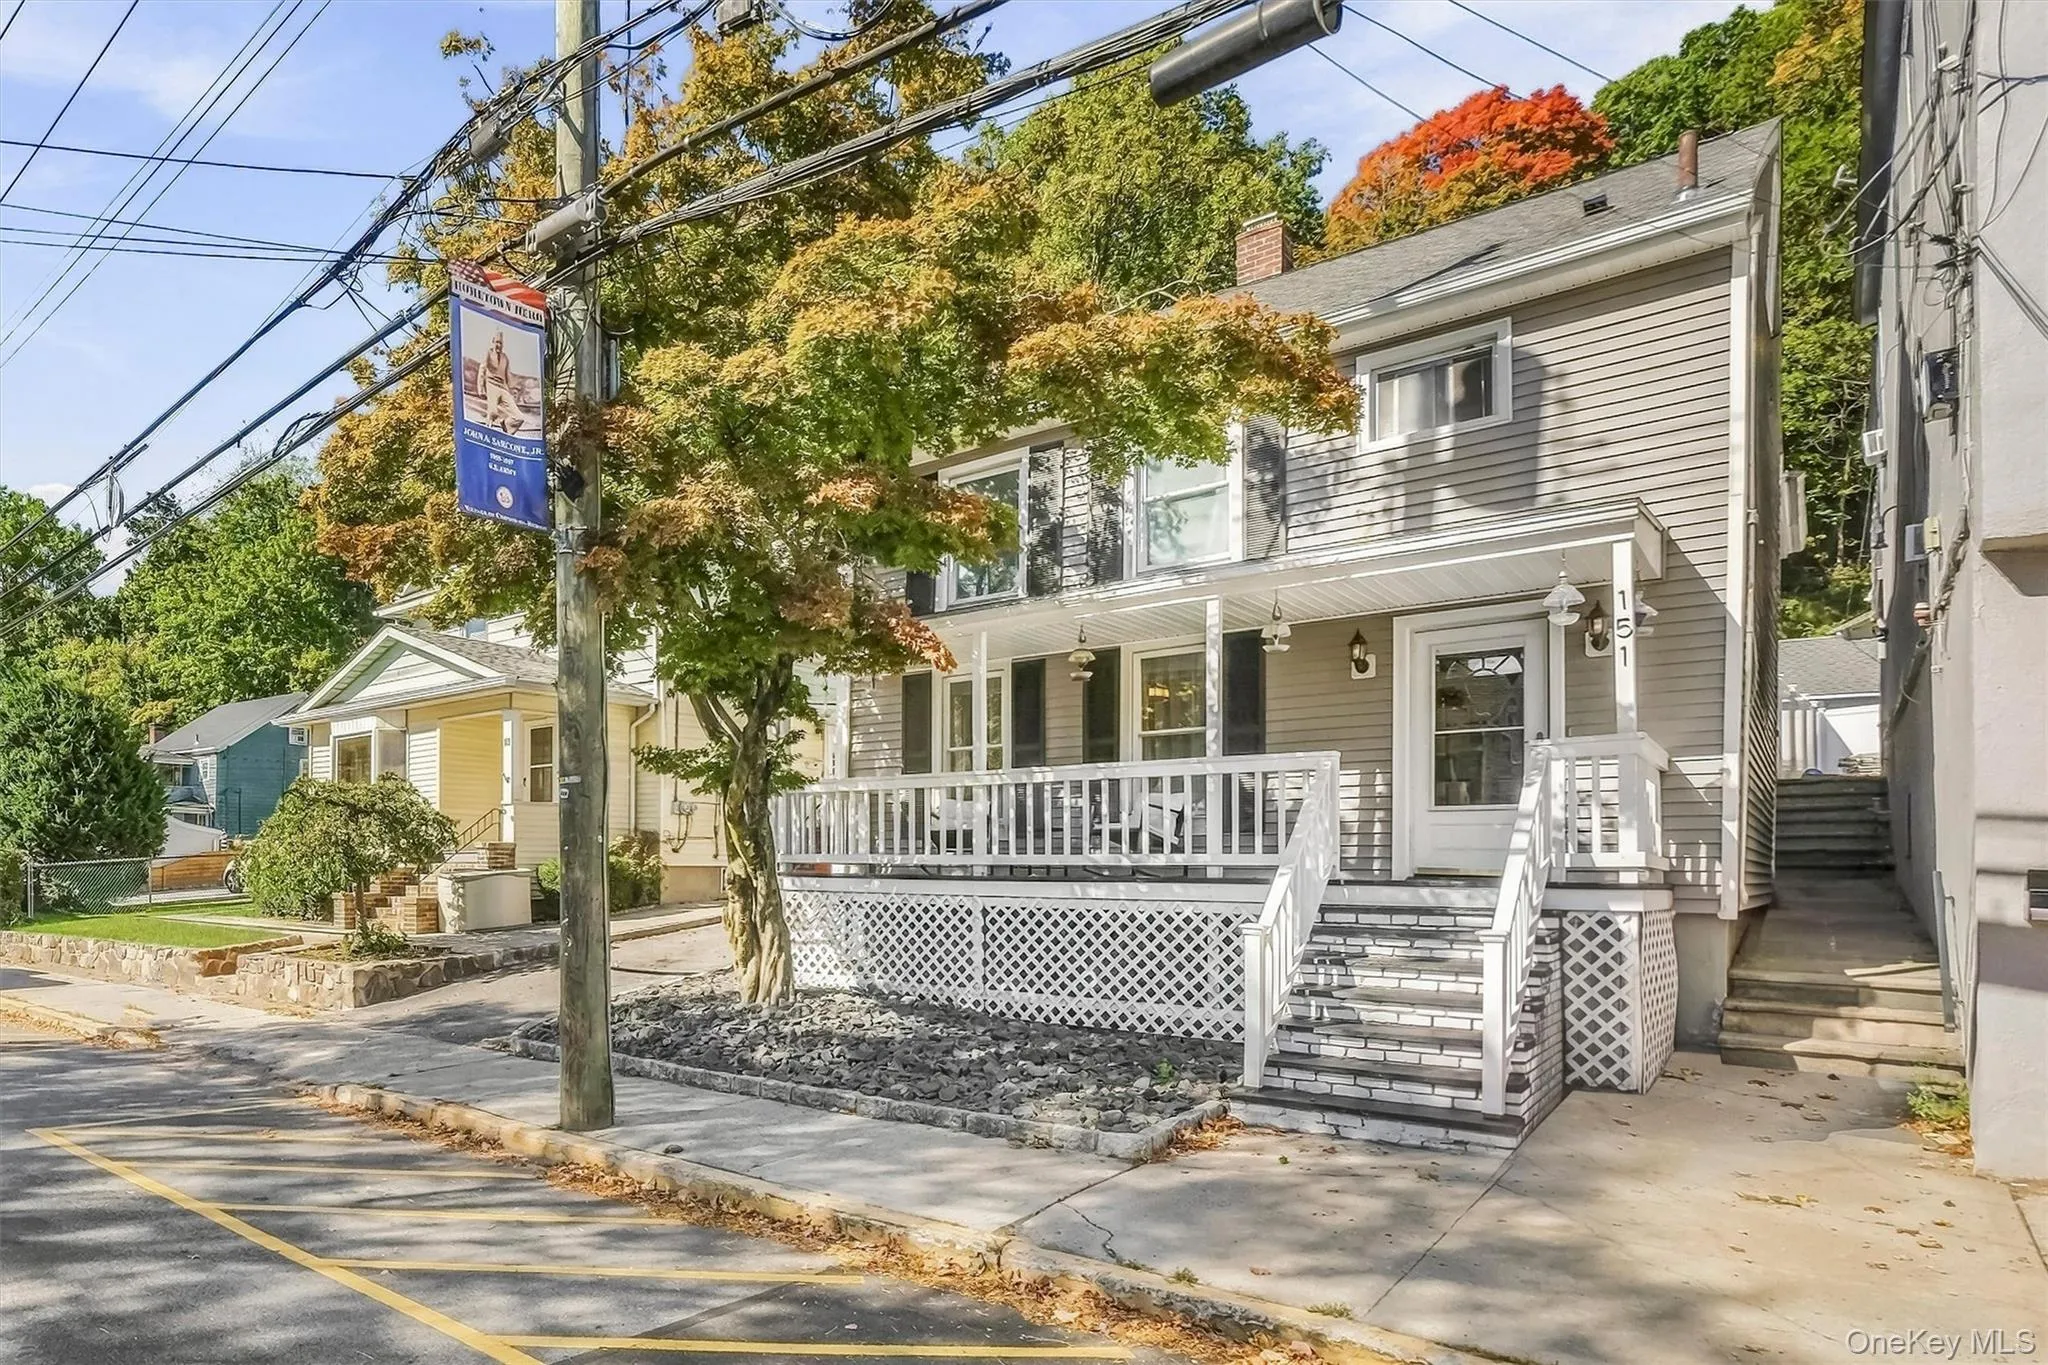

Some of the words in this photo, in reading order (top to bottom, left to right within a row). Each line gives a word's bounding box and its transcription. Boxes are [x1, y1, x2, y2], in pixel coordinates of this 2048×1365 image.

[454, 280, 511, 312] HOMETOWN
[515, 304, 543, 323] HERO
[463, 427, 484, 441] JOHN
[1617, 589, 1634, 668] 151
